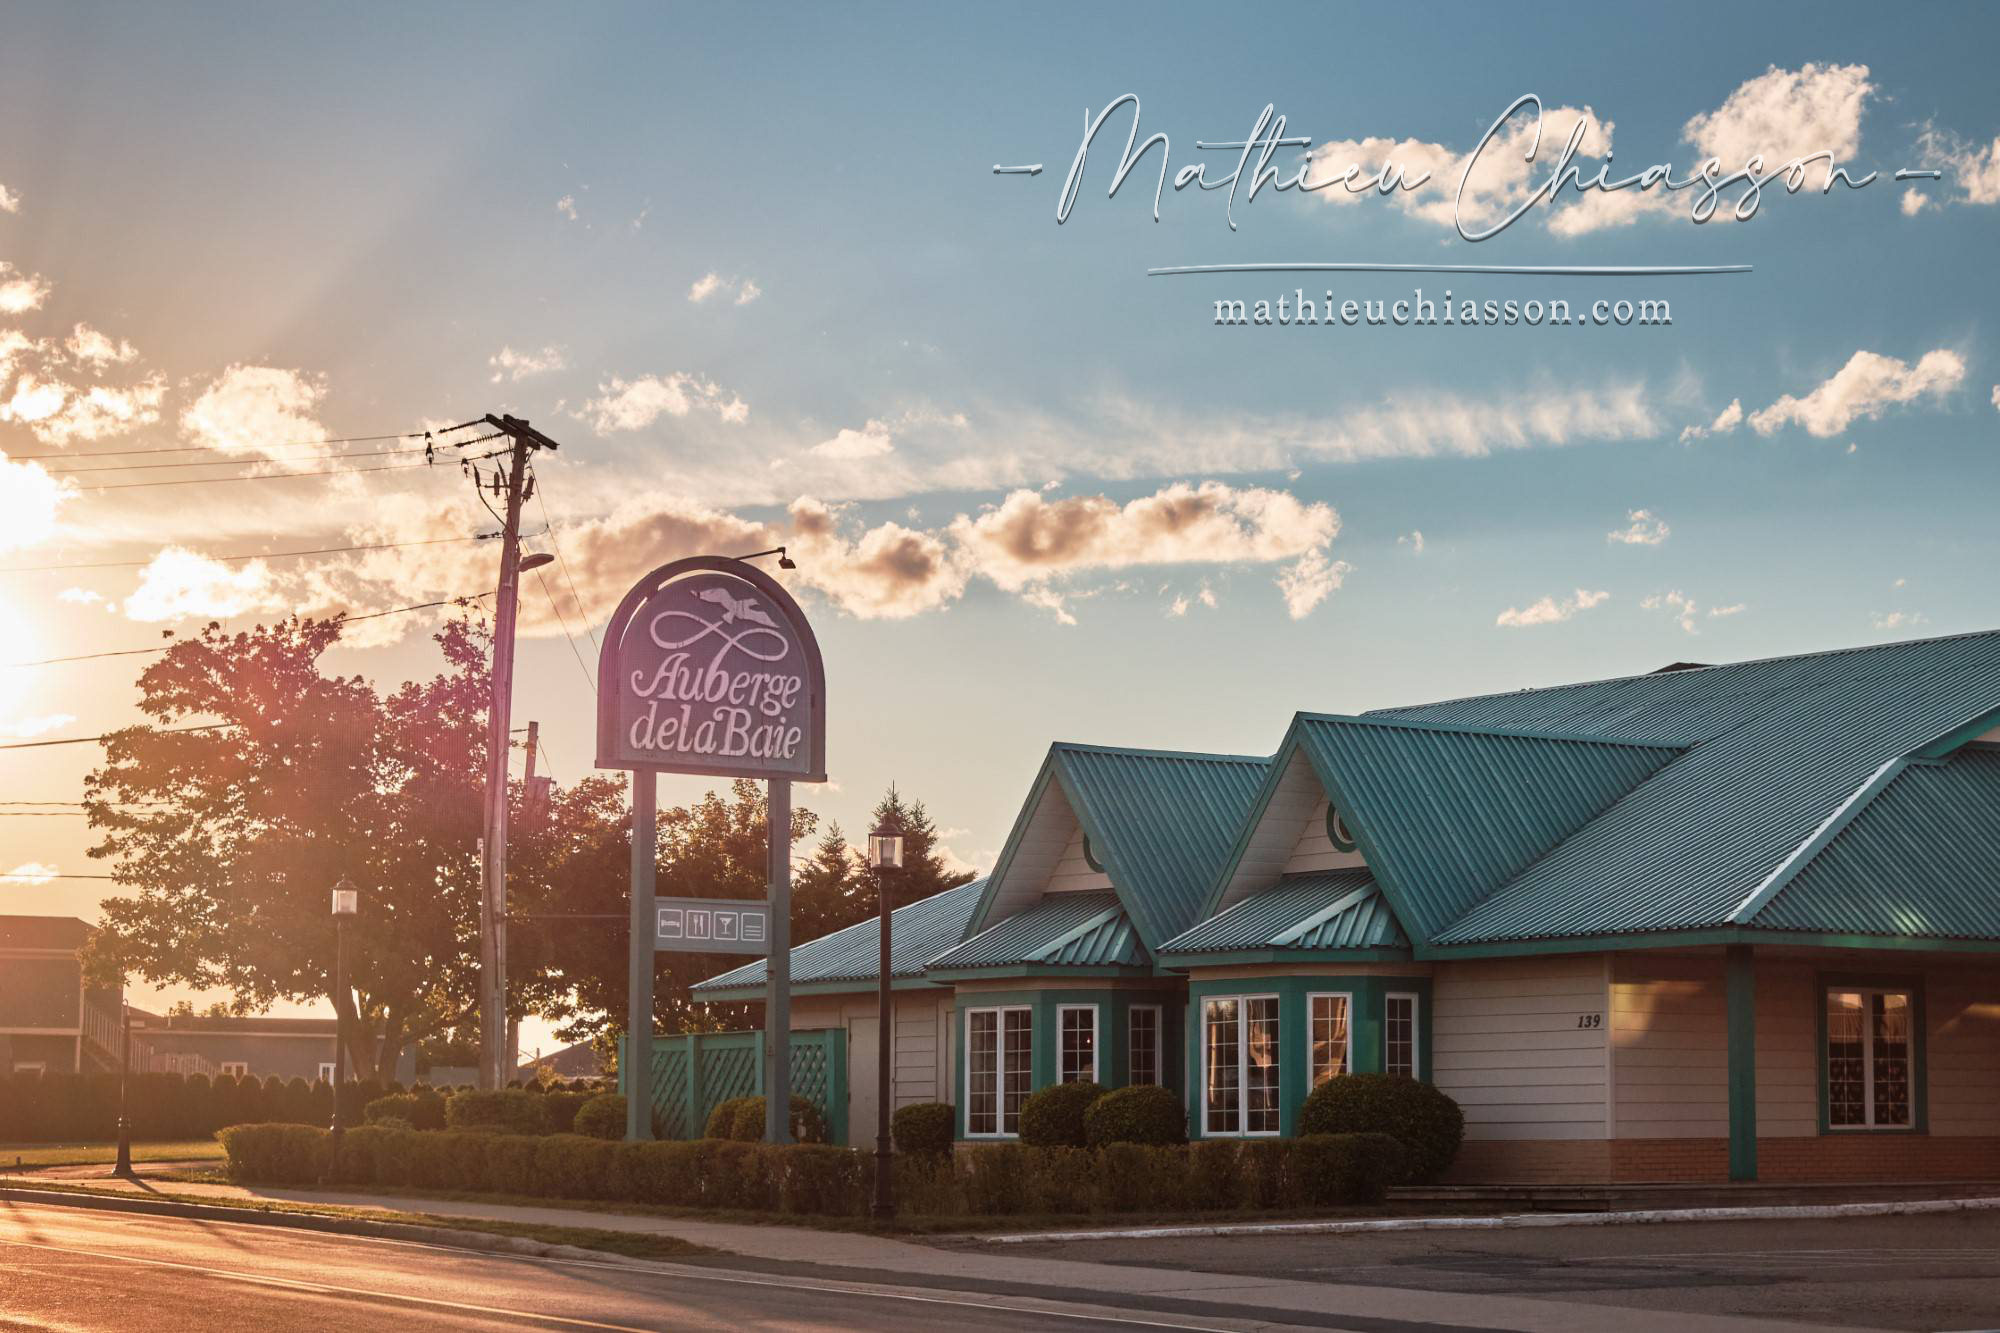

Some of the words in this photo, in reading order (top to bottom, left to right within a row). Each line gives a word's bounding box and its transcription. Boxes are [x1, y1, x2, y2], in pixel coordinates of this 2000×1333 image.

[630, 628, 801, 717] Auberge
[712, 705, 802, 760] Baie
[1577, 1013, 1601, 1029] 139
